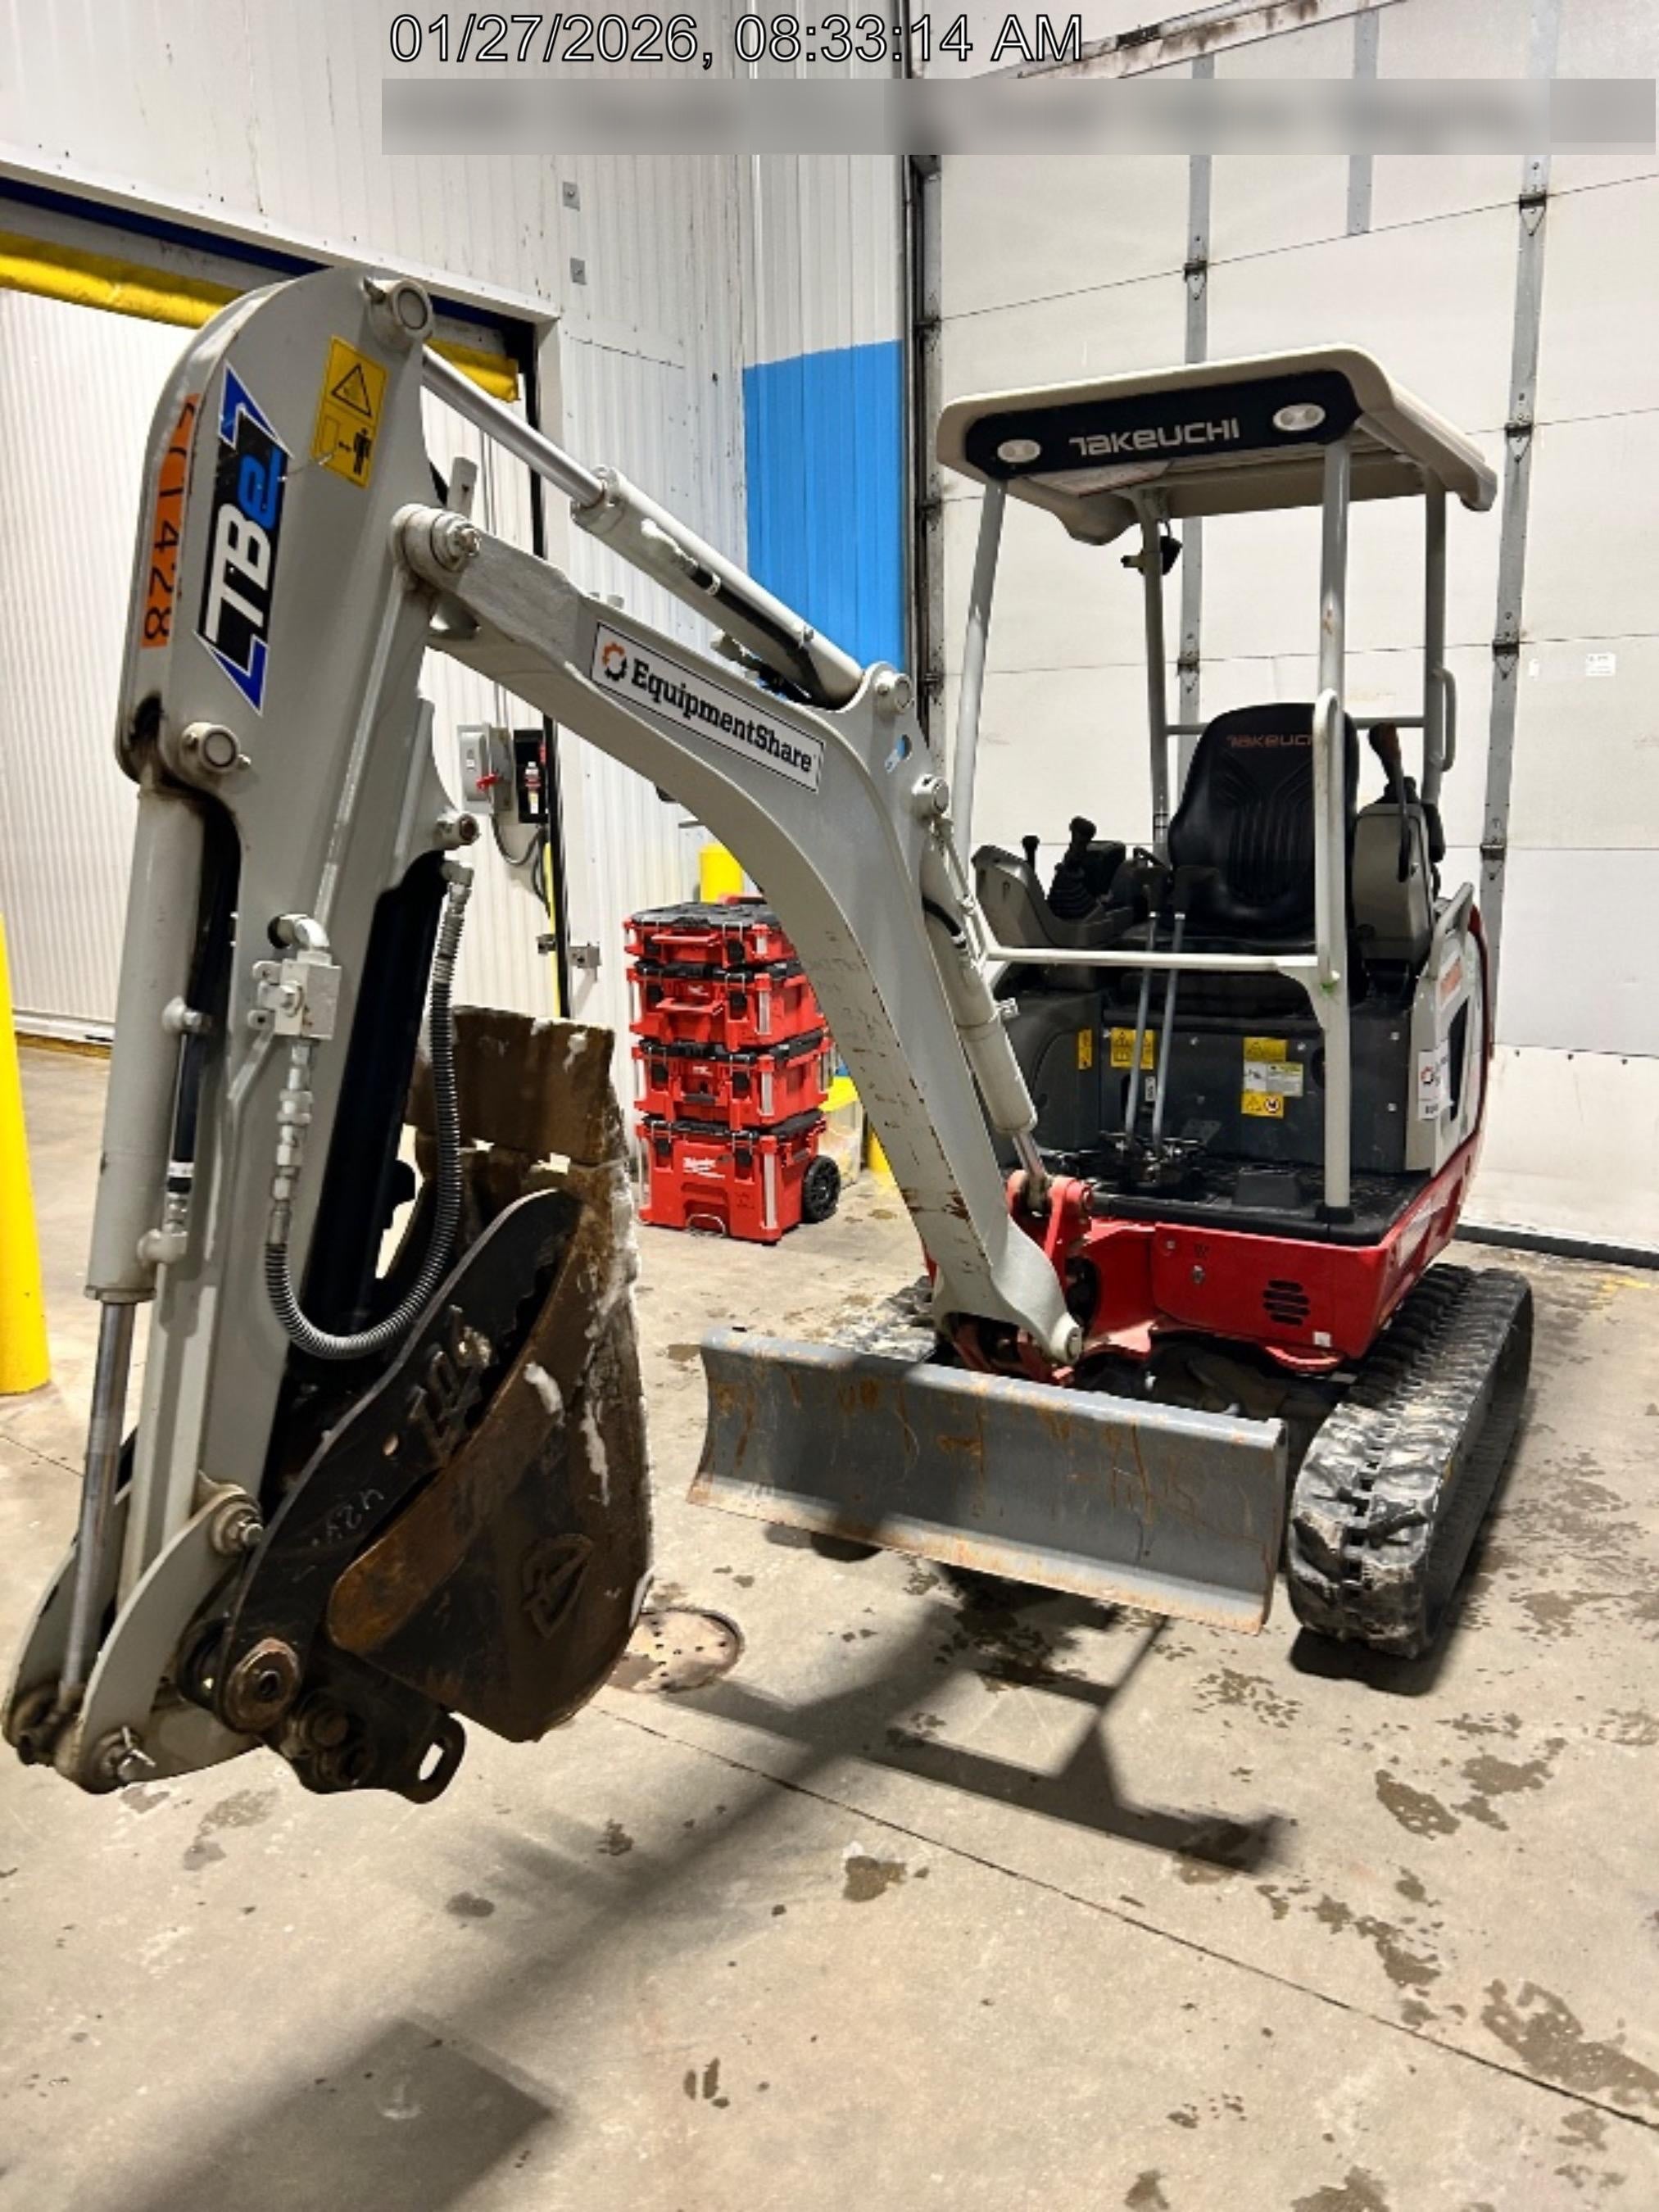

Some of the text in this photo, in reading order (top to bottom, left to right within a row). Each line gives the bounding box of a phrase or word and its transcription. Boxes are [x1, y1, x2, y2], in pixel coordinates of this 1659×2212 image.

[1068, 417, 1240, 456] TAKEUCHI
[630, 658, 813, 773] EquipmentShare
[1226, 734, 1312, 747] TAKEUC
